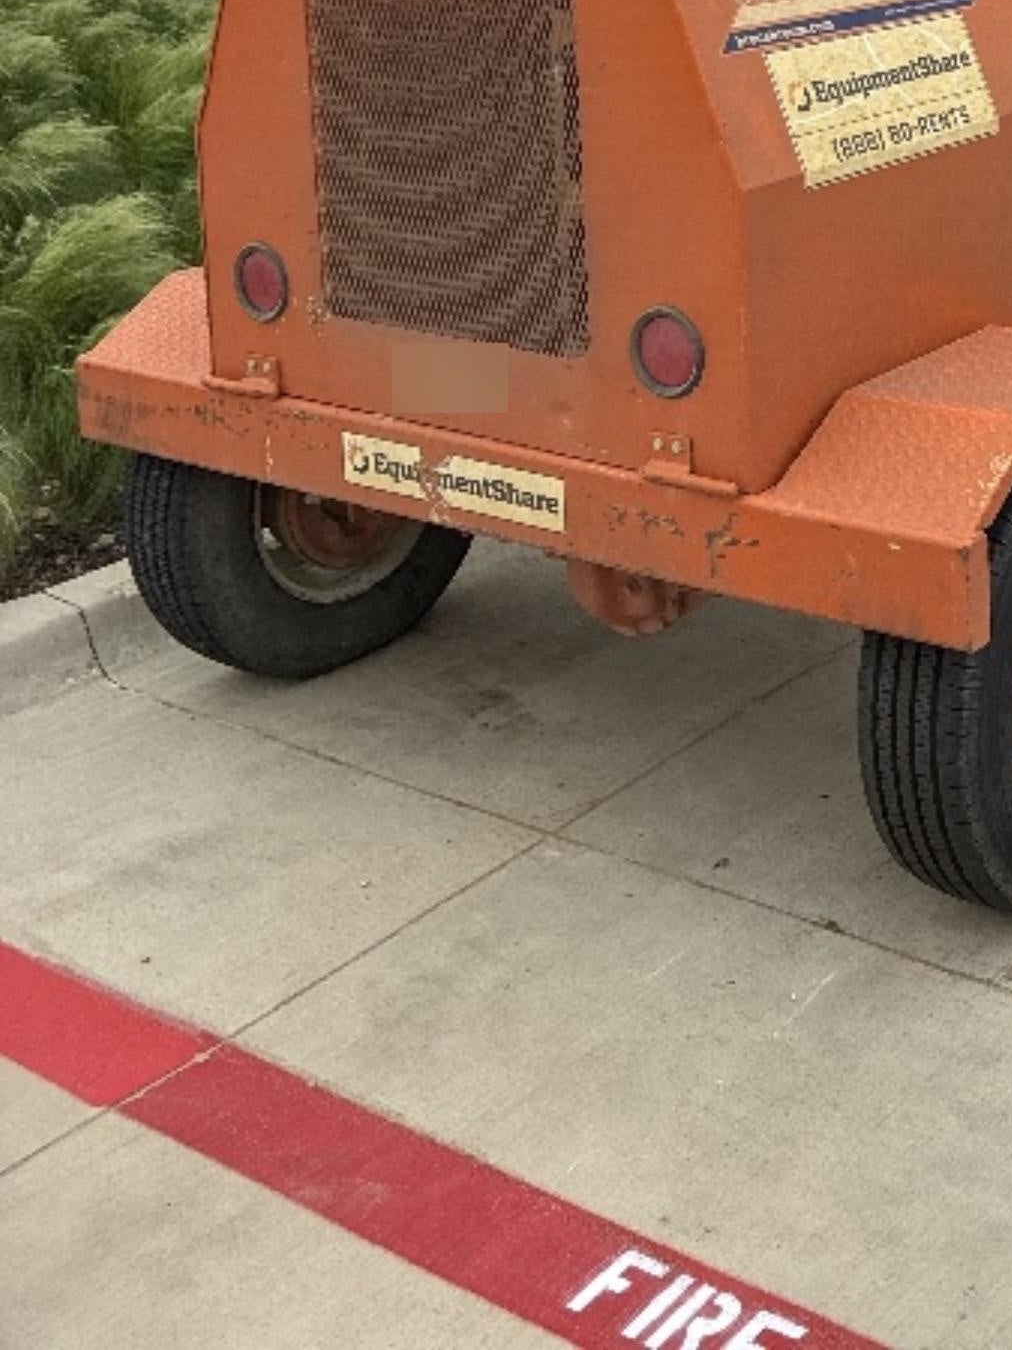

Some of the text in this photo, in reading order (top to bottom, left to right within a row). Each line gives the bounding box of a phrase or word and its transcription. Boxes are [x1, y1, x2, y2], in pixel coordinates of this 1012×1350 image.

[811, 50, 973, 105] EquipmentShare
[373, 453, 559, 513] EquimentShare
[565, 1249, 809, 1350] FIRE
